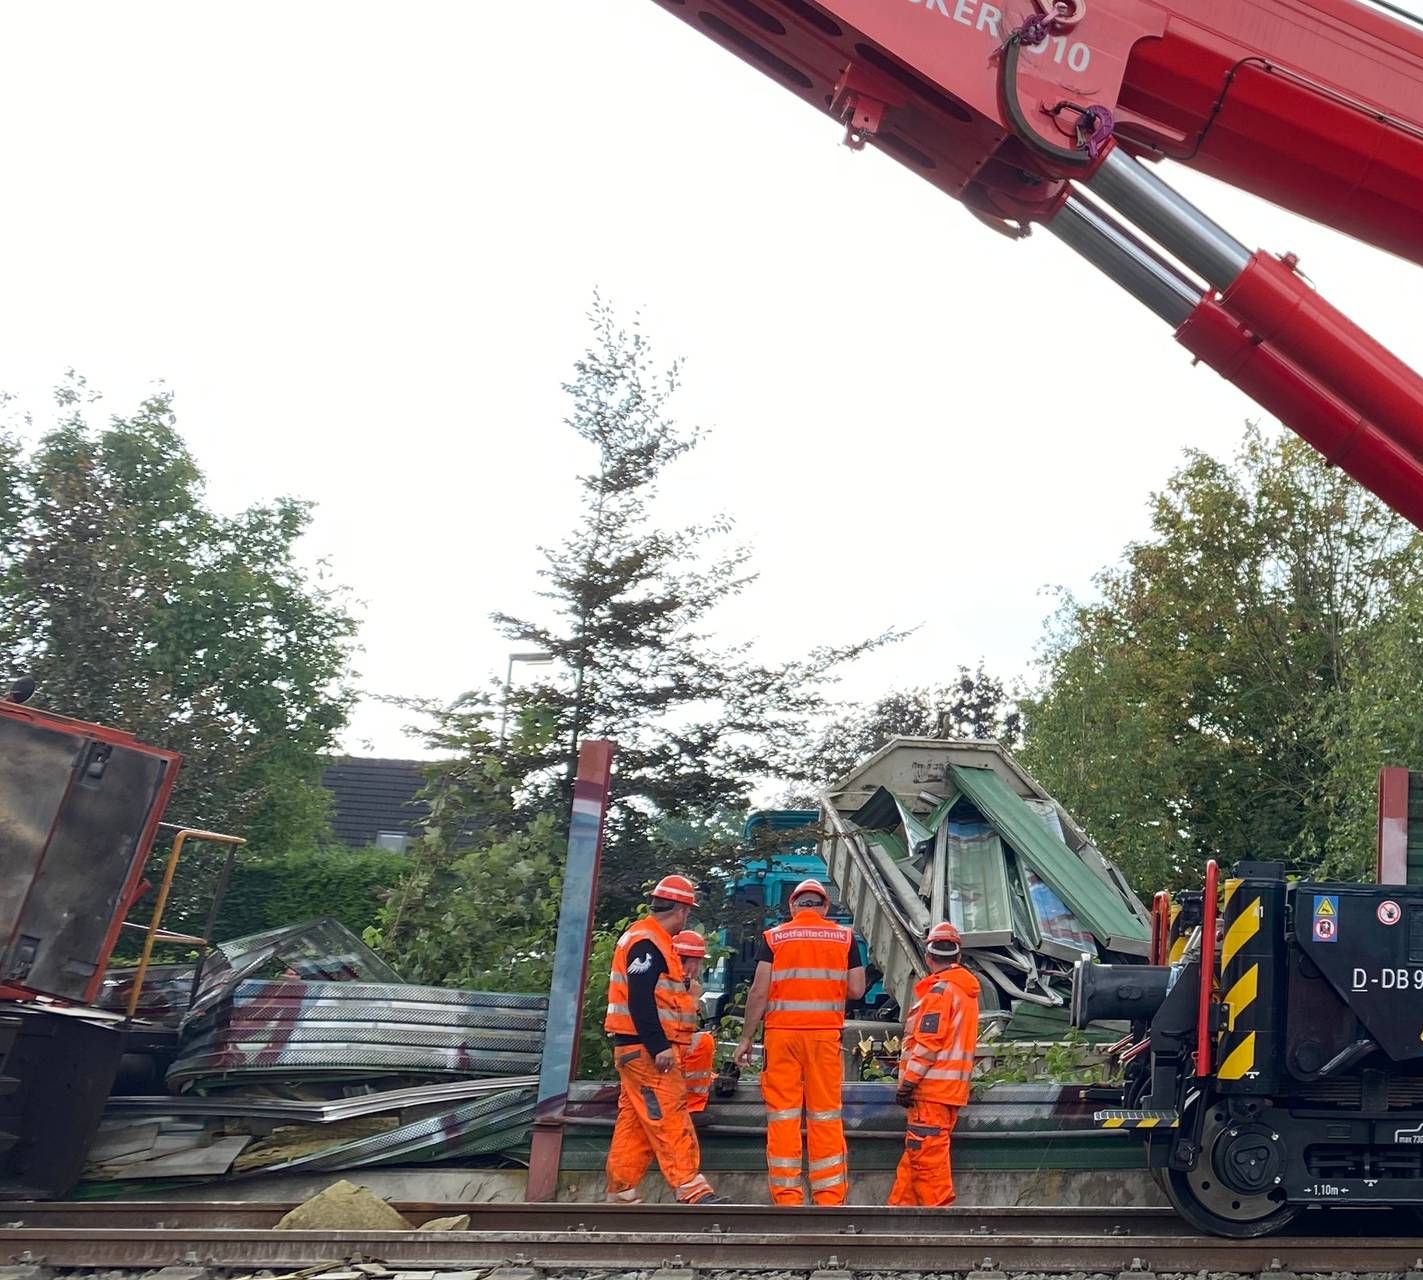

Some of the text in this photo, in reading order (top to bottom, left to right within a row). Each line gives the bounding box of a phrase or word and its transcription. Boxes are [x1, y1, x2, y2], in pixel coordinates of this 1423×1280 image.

[774, 929, 846, 941] Notfalltechnik
[1353, 968, 1367, 990] D
[1382, 969, 1409, 989] DB
[1413, 1135, 1423, 1143] 730
[1313, 1184, 1339, 1196] 1,10m
